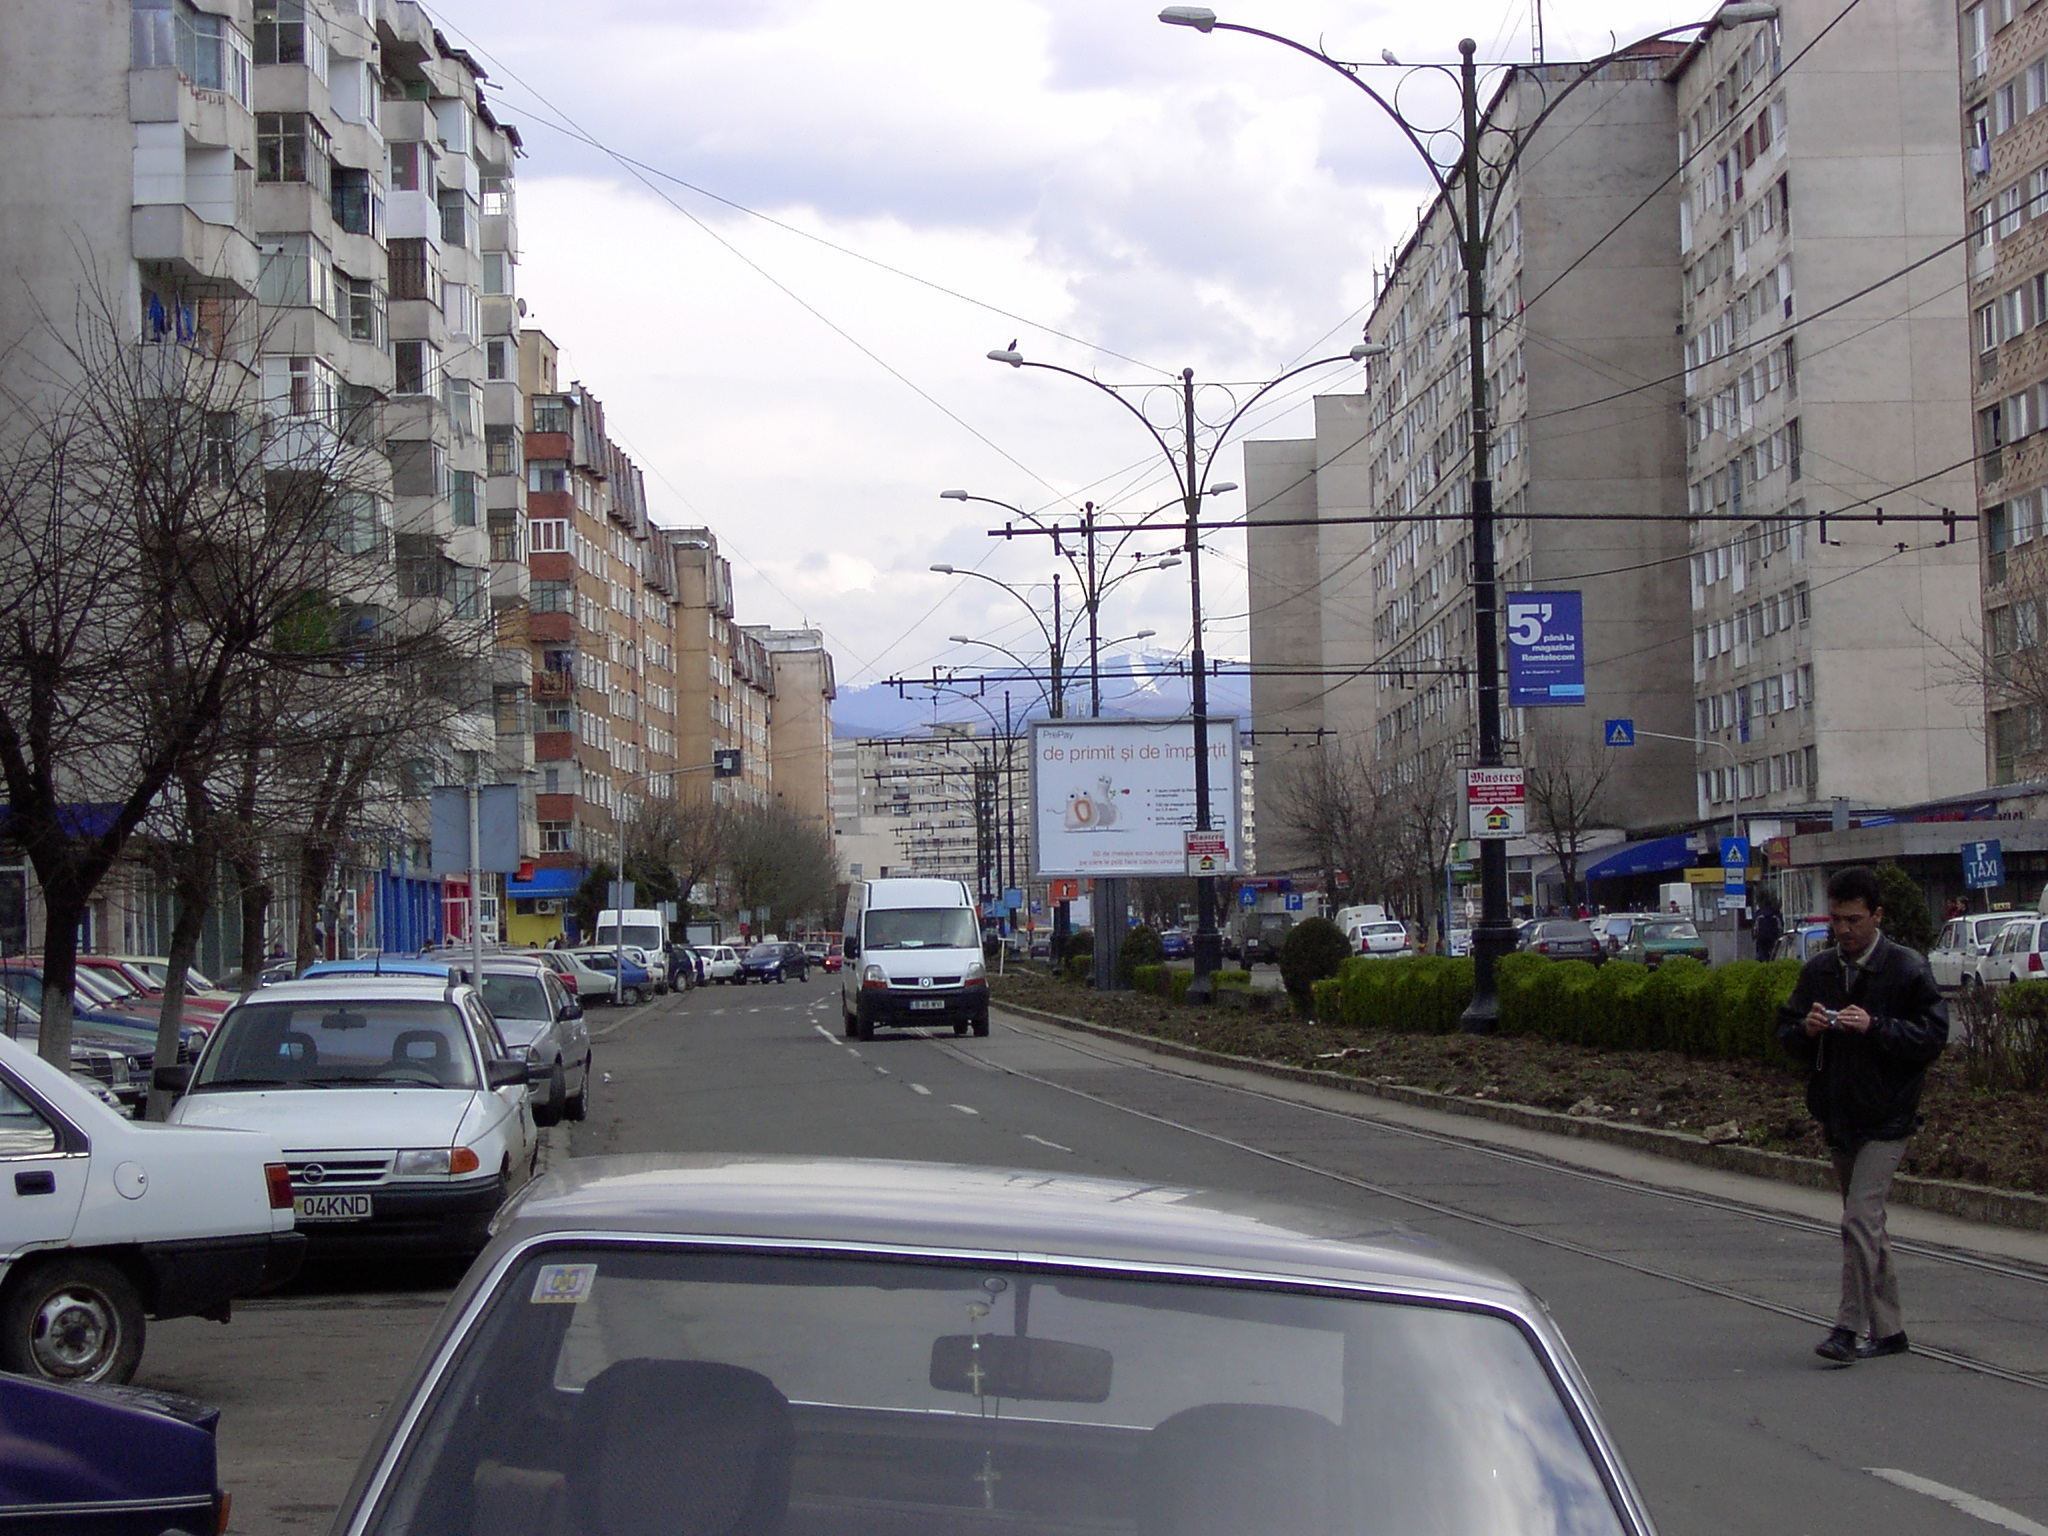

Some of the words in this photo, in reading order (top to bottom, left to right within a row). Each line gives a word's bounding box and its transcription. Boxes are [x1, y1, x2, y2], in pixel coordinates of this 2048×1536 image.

[1508, 604, 1552, 645] 5'
[1566, 633, 1575, 641] la
[1532, 643, 1575, 653] magazinul
[1521, 653, 1576, 662] Romtelecom
[1043, 730, 1074, 740] PrePay
[1043, 746, 1064, 761] de
[1070, 745, 1115, 763] primit
[1139, 744, 1160, 759] de
[1470, 772, 1522, 783] Masters
[1975, 843, 1987, 861] P
[1969, 859, 1998, 878] TAXI
[1288, 894, 1300, 908] P
[303, 1195, 369, 1216] 04KND
